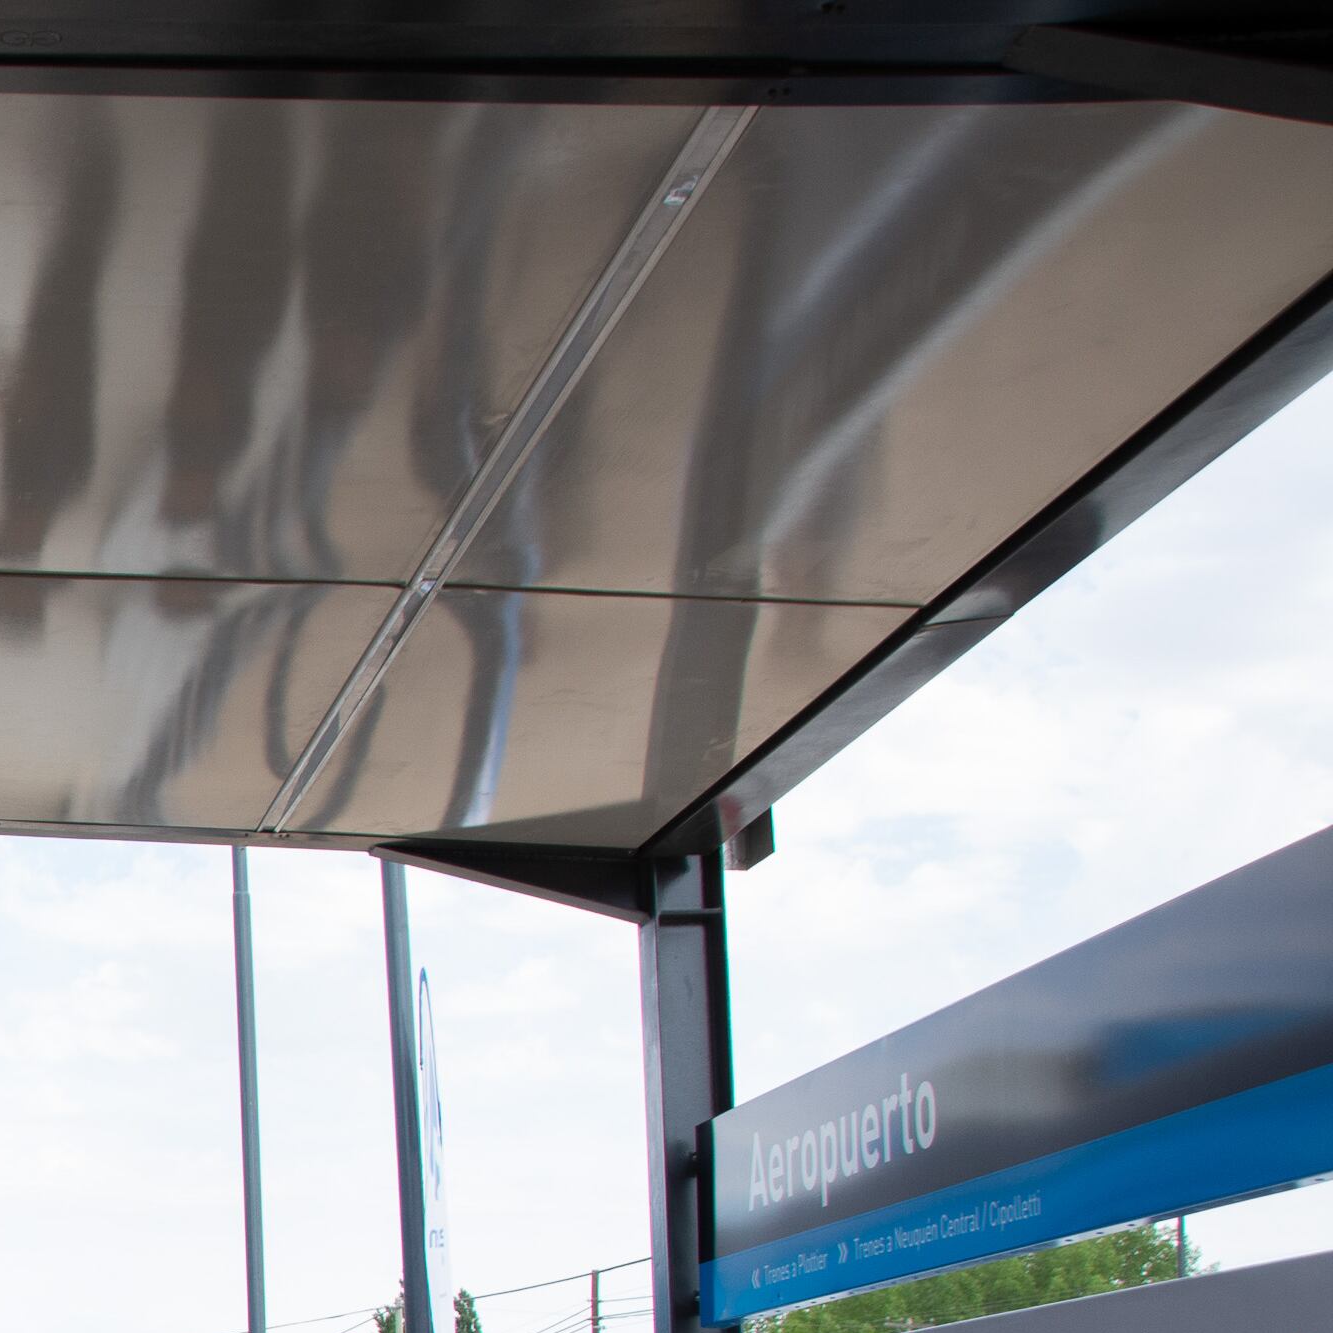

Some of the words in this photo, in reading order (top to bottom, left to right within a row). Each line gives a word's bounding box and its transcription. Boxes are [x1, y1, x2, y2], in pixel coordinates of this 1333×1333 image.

[748, 1072, 936, 1212] Aeropuerto
[763, 1263, 790, 1286] Trenes
[853, 1237, 886, 1261] Trenes
[886, 1235, 893, 1253] a
[894, 1218, 938, 1250] Neuquén
[940, 1207, 980, 1239] Central
[989, 1190, 1042, 1232] Cipolletti
